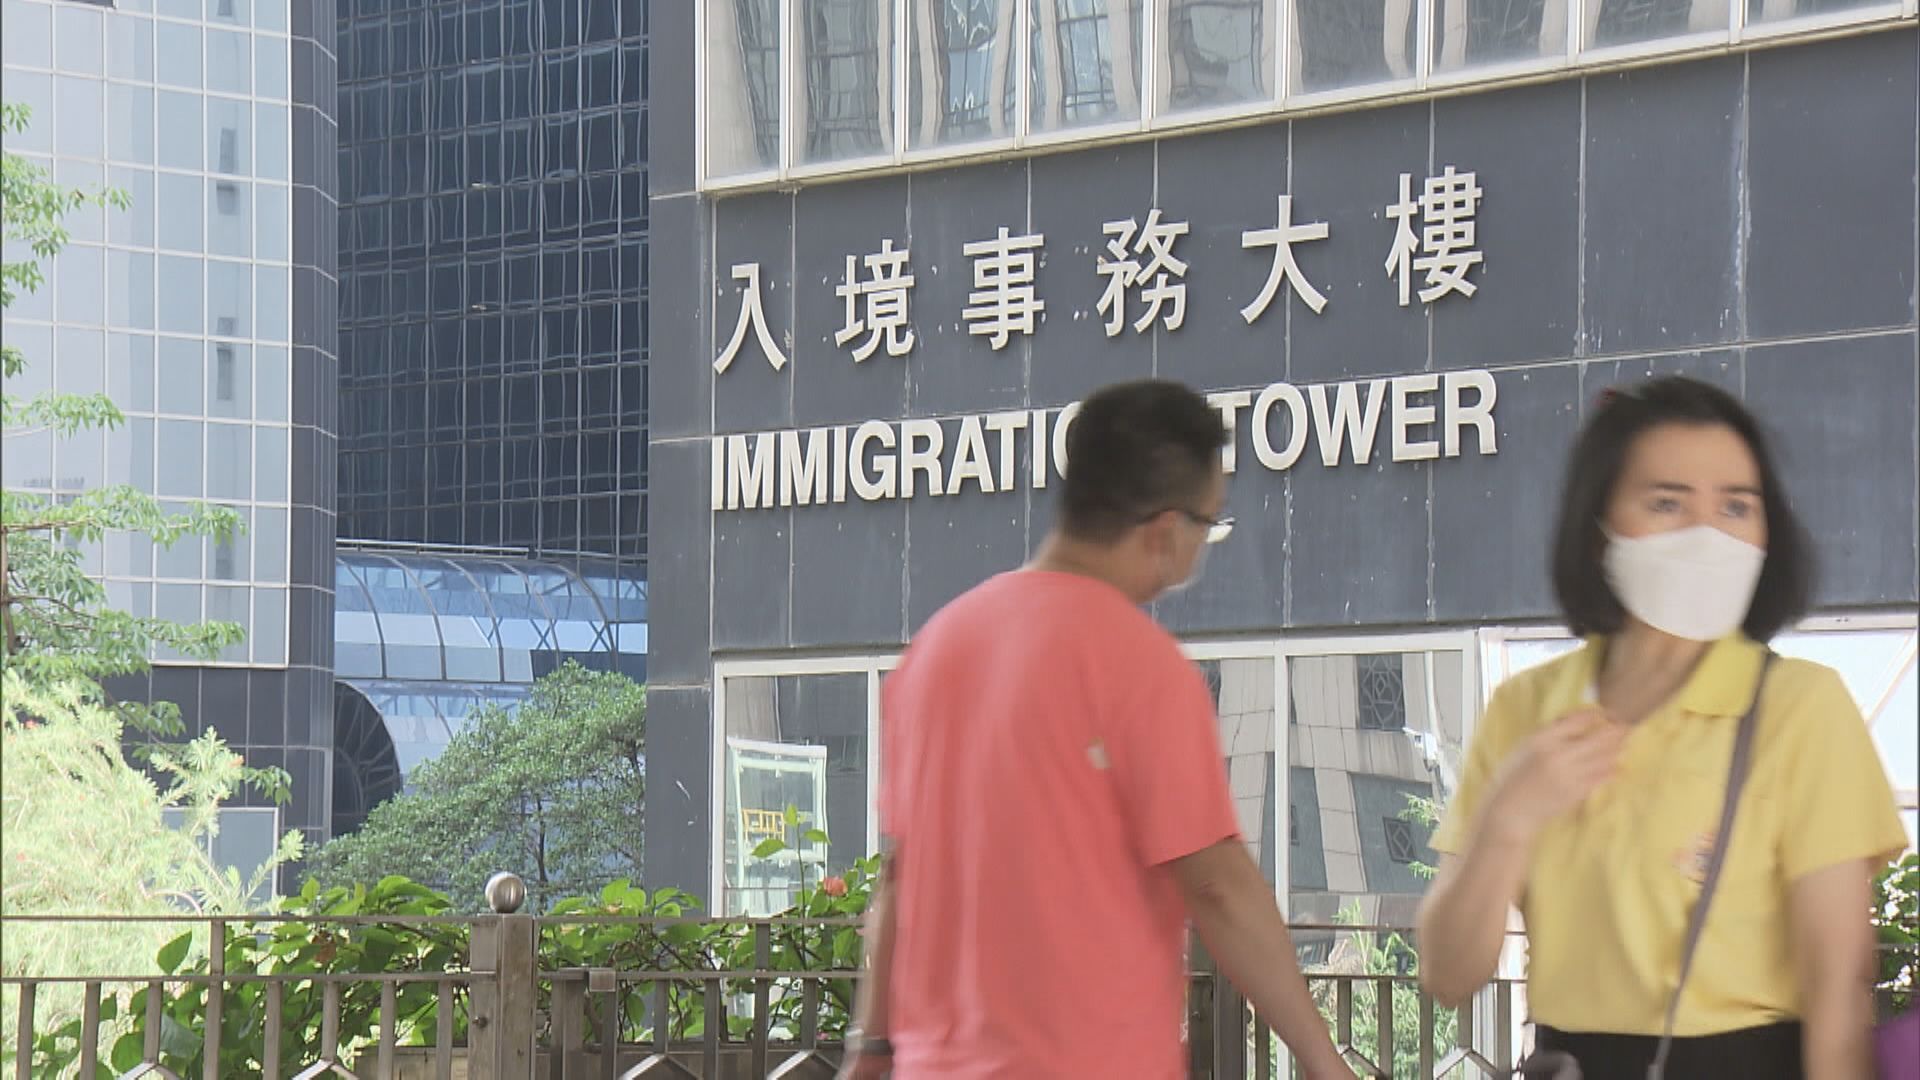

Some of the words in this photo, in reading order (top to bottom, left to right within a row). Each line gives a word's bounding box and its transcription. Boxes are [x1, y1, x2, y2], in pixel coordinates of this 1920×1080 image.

[713, 166, 1484, 374] 入境事務大樓
[711, 401, 1082, 511] IMMIGRATI
[1206, 369, 1498, 474] TOWER
